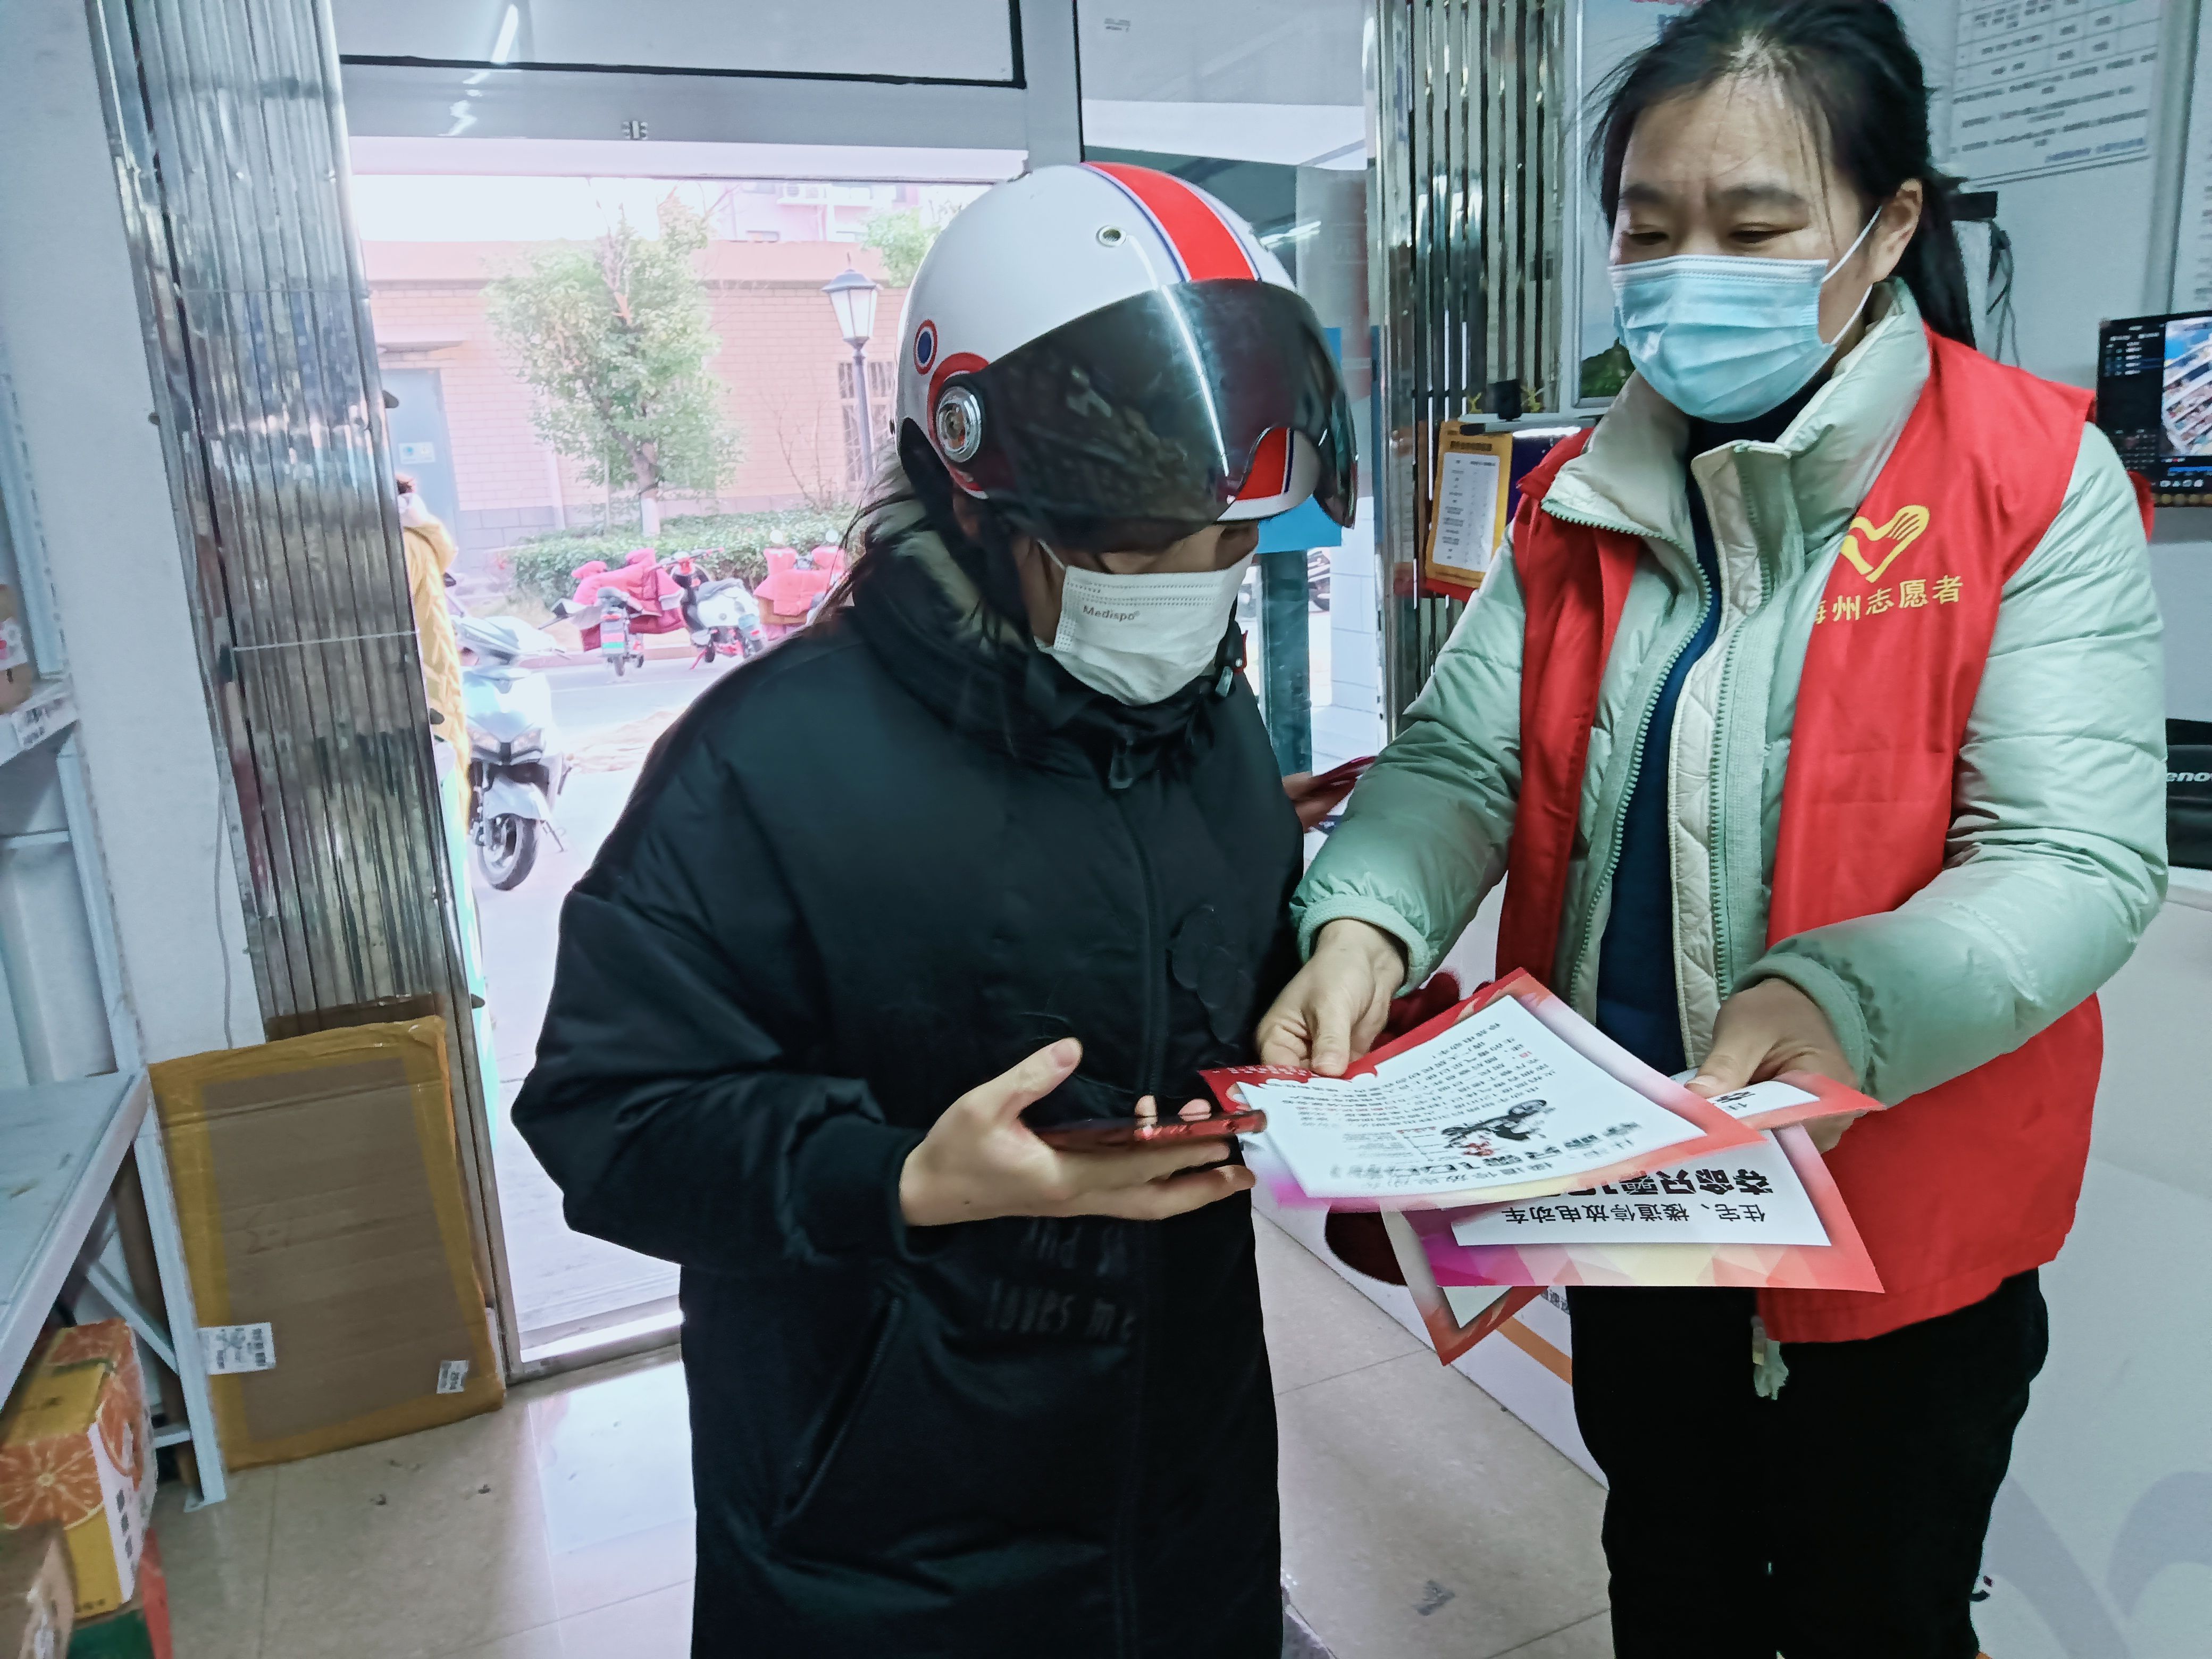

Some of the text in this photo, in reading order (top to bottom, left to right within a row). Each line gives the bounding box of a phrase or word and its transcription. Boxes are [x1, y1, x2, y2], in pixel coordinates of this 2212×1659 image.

[2167, 772, 2212, 782] eno
[1501, 1203, 1767, 1224] 住宅、楼道停放电动车
